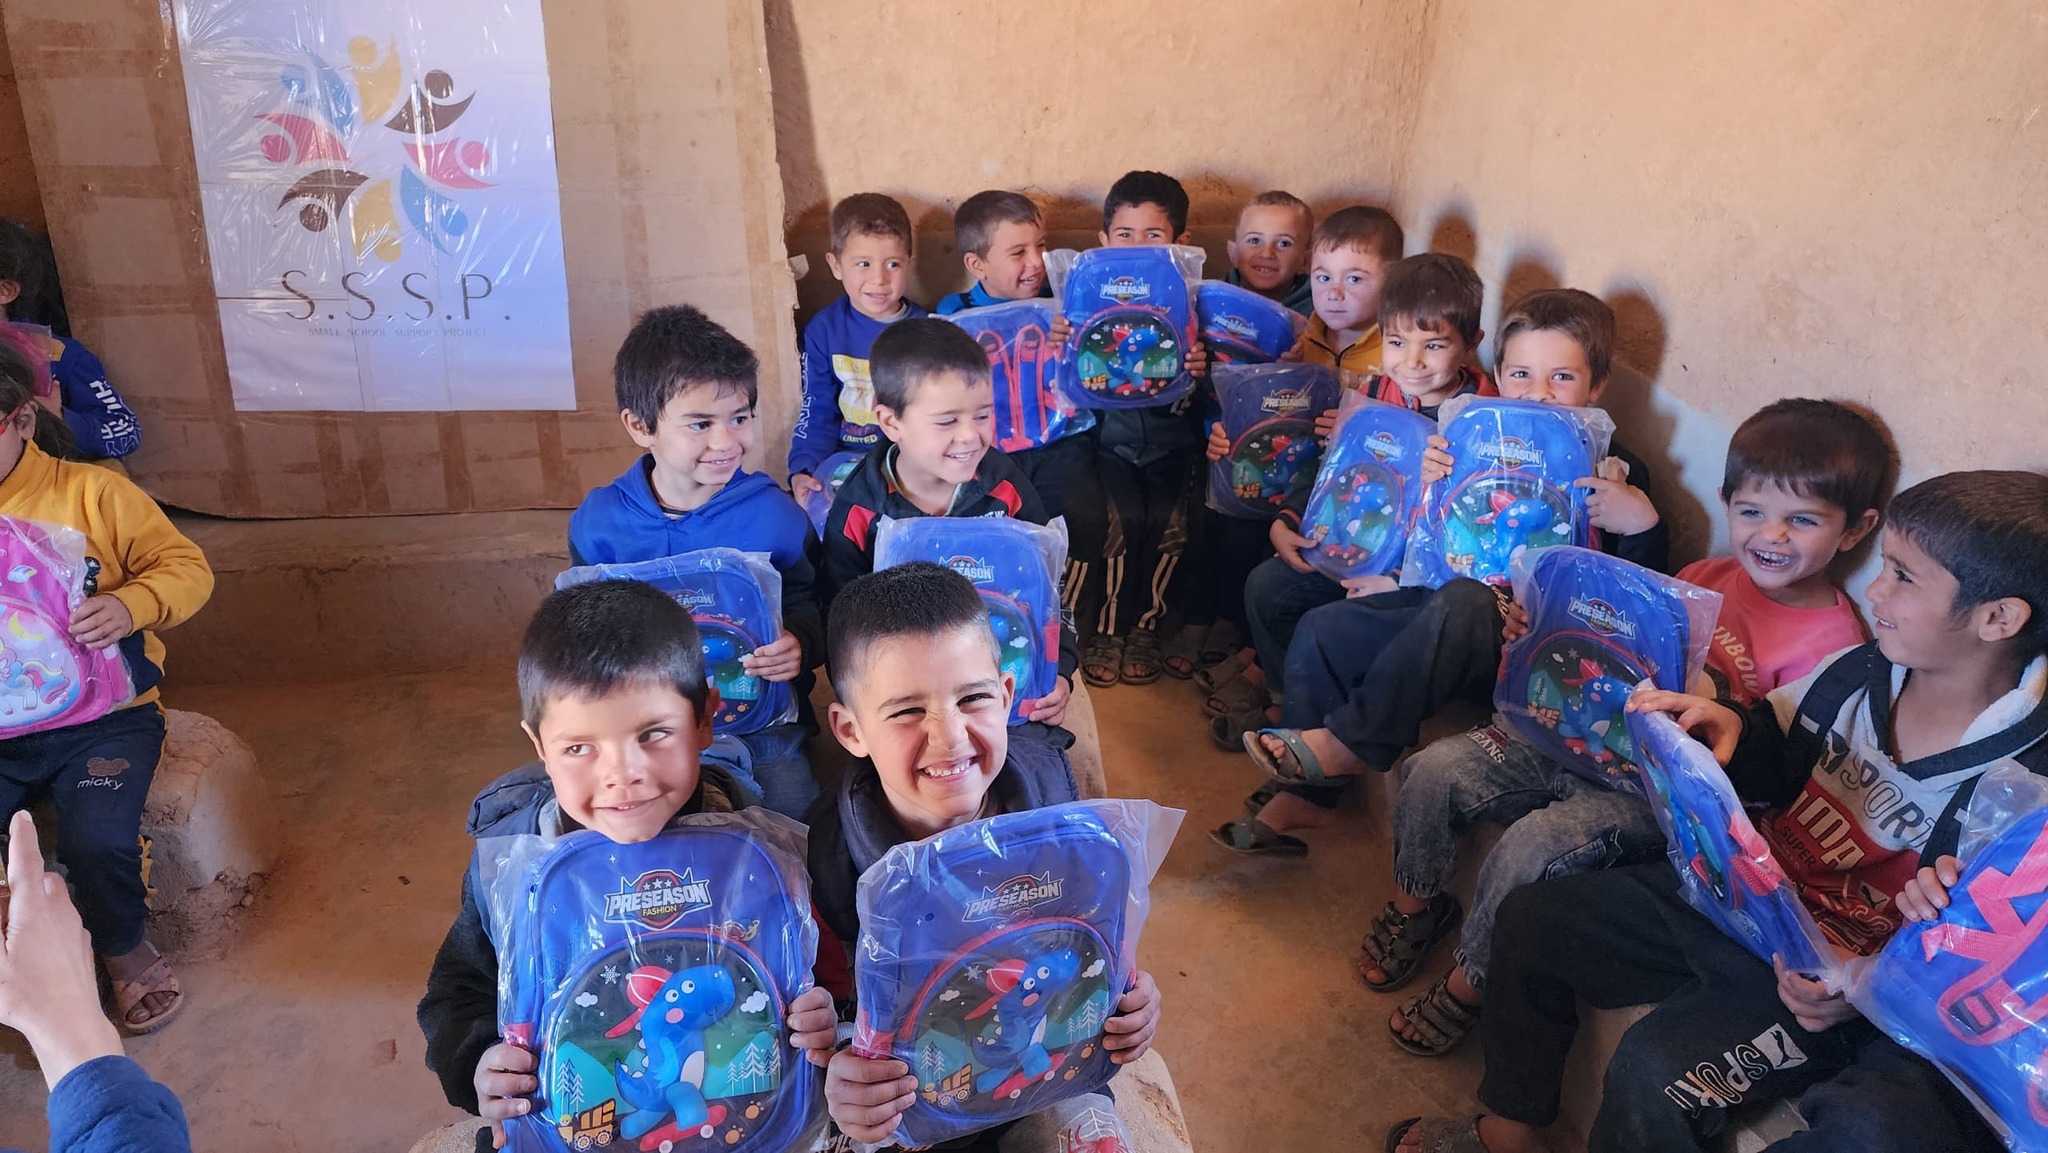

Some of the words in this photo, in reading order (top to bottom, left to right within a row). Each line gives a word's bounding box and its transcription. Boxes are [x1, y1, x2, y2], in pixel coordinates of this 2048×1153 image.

[281, 269, 511, 320] S.S.S.P.
[308, 327, 341, 337] SMALL
[347, 327, 387, 337] SCHOOL
[395, 328, 439, 338] SUPPORT
[443, 327, 487, 338] PROJECT
[957, 566, 993, 580] EASON
[676, 596, 713, 606] EASON
[1570, 600, 1633, 637] PRESEASON
[77, 777, 123, 791] micky
[1781, 826, 1816, 867] SUPER
[608, 883, 709, 917] PRESEASON
[642, 904, 677, 916] FASHION
[966, 881, 1060, 919] PRESEASON
